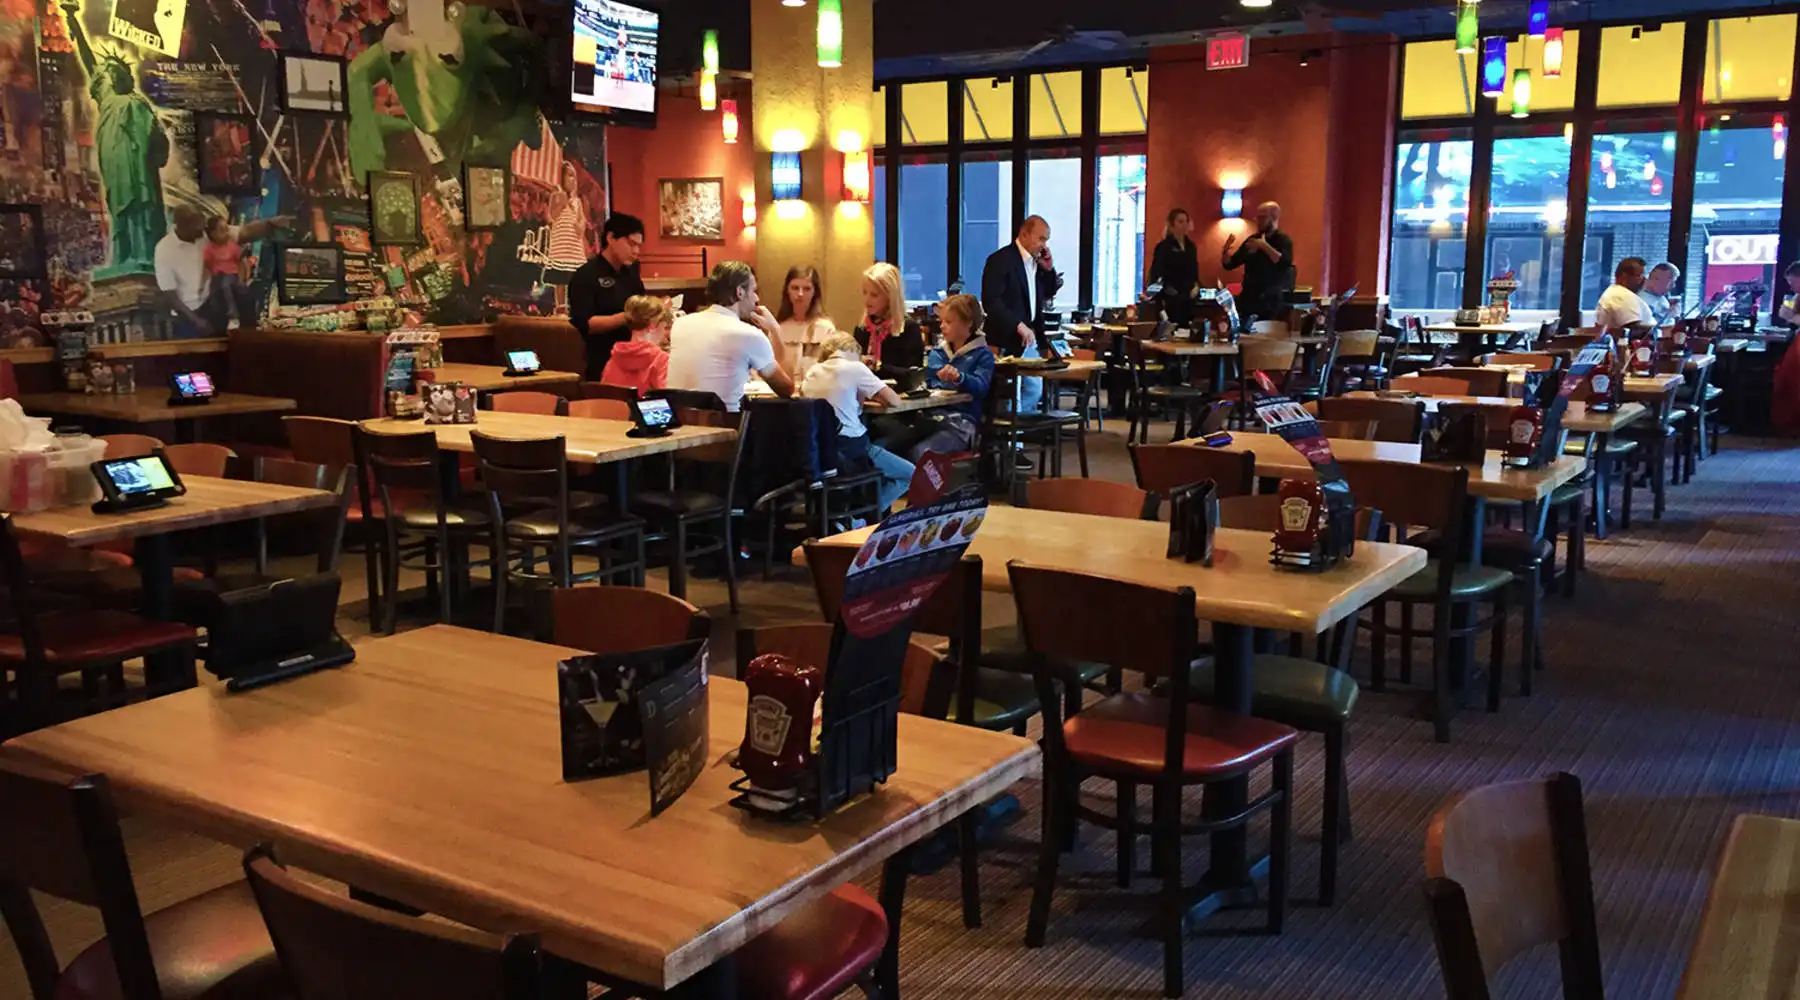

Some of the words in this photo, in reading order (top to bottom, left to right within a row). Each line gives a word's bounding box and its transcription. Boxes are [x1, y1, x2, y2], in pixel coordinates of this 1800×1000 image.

[112, 18, 162, 48] WICKED
[157, 62, 178, 72] THE
[184, 63, 206, 72] NEW
[212, 63, 240, 72] YORK
[1208, 38, 1244, 67] EXIT
